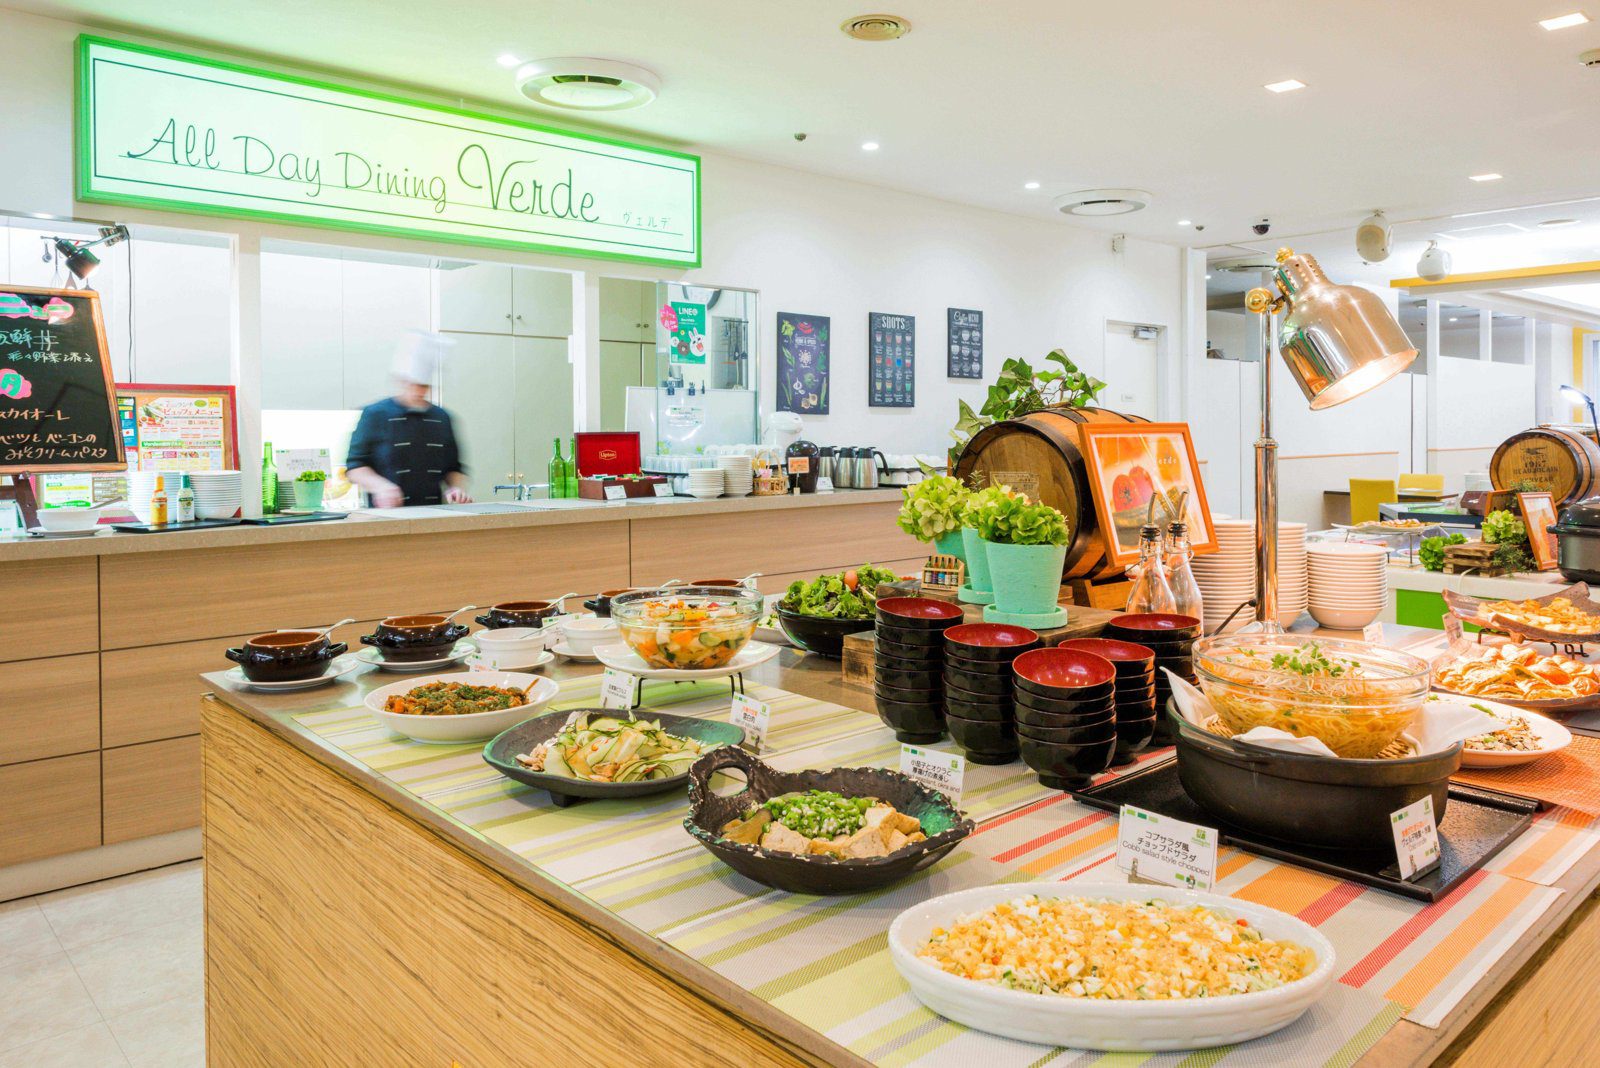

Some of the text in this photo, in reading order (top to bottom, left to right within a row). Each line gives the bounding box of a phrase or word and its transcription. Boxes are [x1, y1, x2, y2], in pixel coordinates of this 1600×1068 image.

[127, 117, 601, 223] All Day Dining Verde
[623, 208, 672, 229] ヴェルデ
[678, 307, 698, 316] LINE@
[881, 315, 906, 330] SHOTS
[1137, 837, 1197, 863] チョップドサラダ
[1145, 831, 1190, 852] コブサラダ風
[1122, 840, 1210, 876] Cobb salad style chopped
